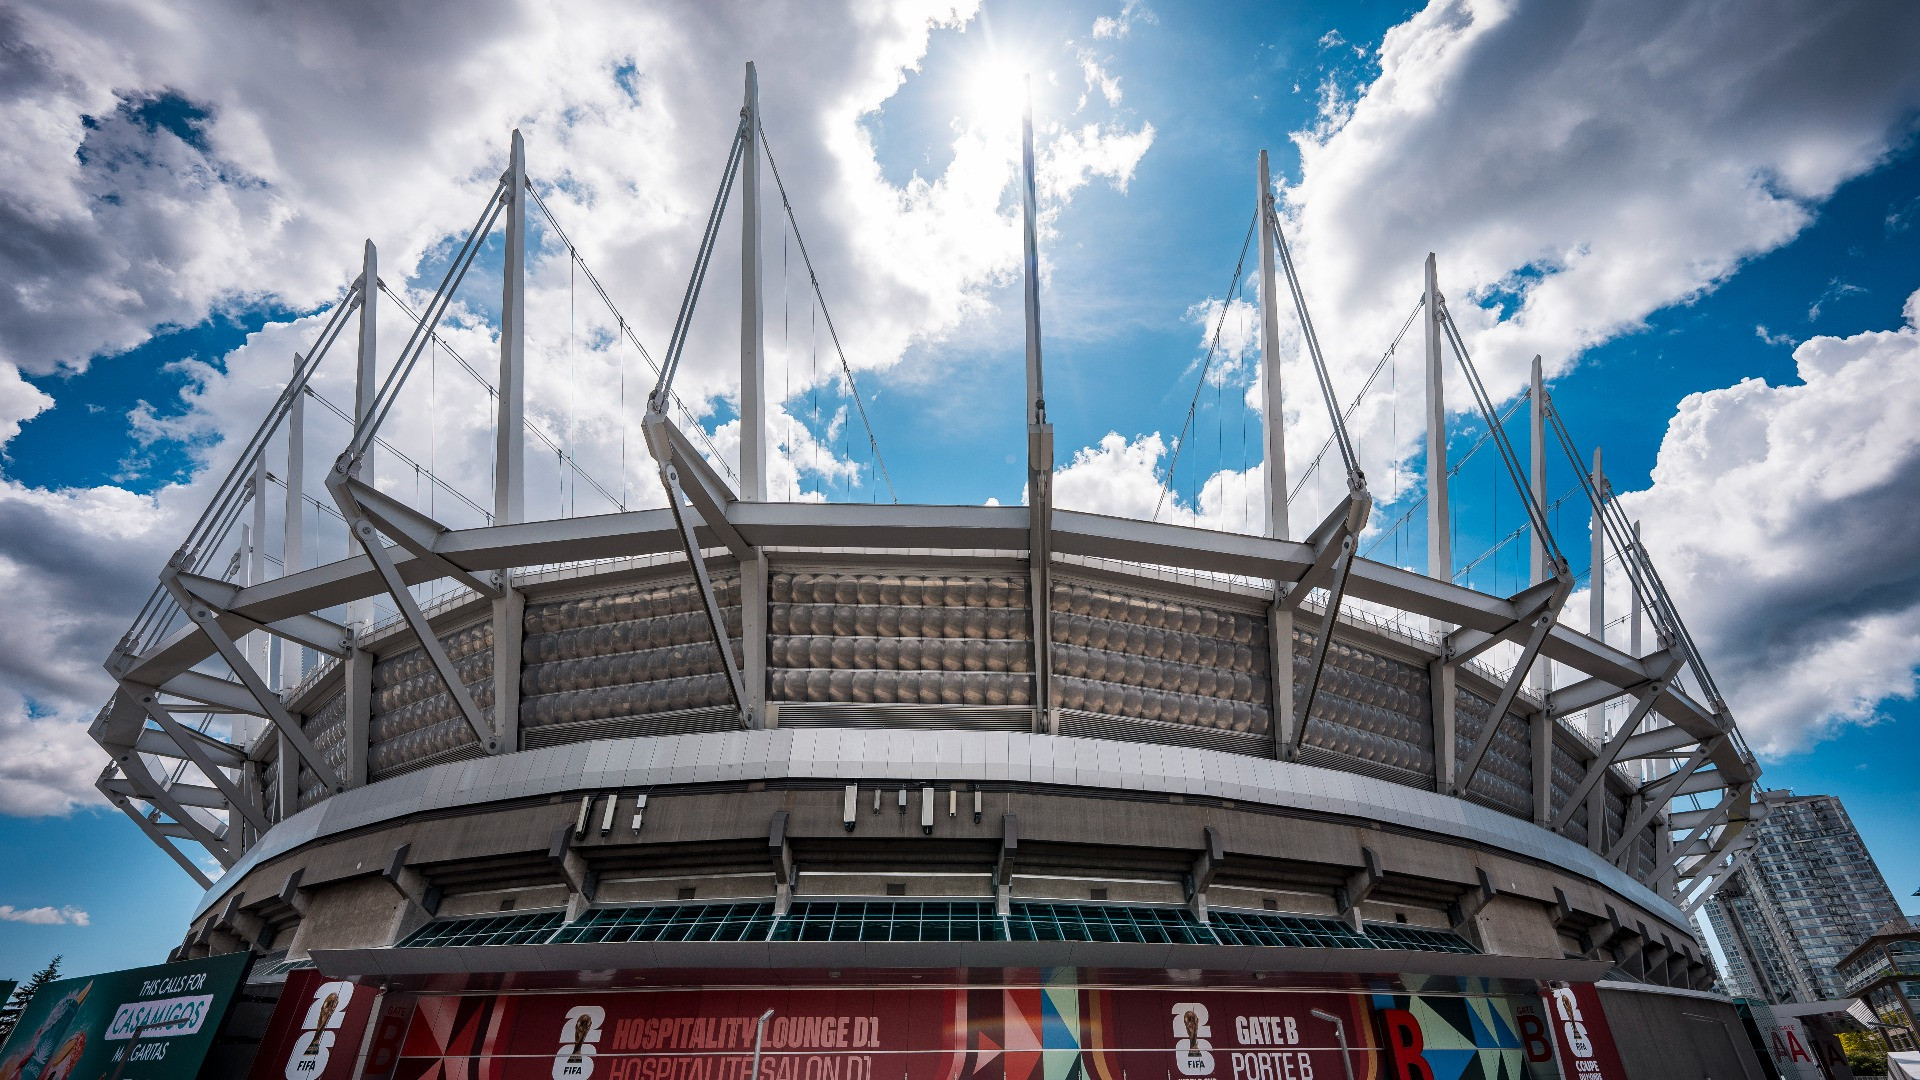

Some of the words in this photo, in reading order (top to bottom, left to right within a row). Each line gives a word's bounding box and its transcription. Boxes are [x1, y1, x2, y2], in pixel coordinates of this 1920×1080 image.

[139, 979, 160, 996] THIS
[159, 975, 187, 994] CALLS
[184, 973, 207, 991] FOR
[112, 1001, 205, 1034] CASAMIGOS
[387, 1005, 407, 1017] GATE
[1516, 1005, 1535, 1015] GATE
[612, 1017, 759, 1050] HOSPITALITY
[760, 1016, 850, 1049] LOUNGE
[852, 1016, 881, 1048] D1
[1235, 1016, 1284, 1045] GATE
[1284, 1016, 1300, 1045] B
[1516, 1014, 1552, 1062] B
[111, 1042, 169, 1062] MGARITAS
[364, 1016, 405, 1075] B
[1786, 1030, 1812, 1063] A
[297, 1060, 316, 1071] FIFA
[563, 1066, 582, 1075] FIFA
[1188, 1060, 1205, 1069] FIFA
[1231, 1052, 1295, 1080] PORTE
[1297, 1052, 1314, 1080] B
[1575, 1060, 1600, 1072] COUPE
